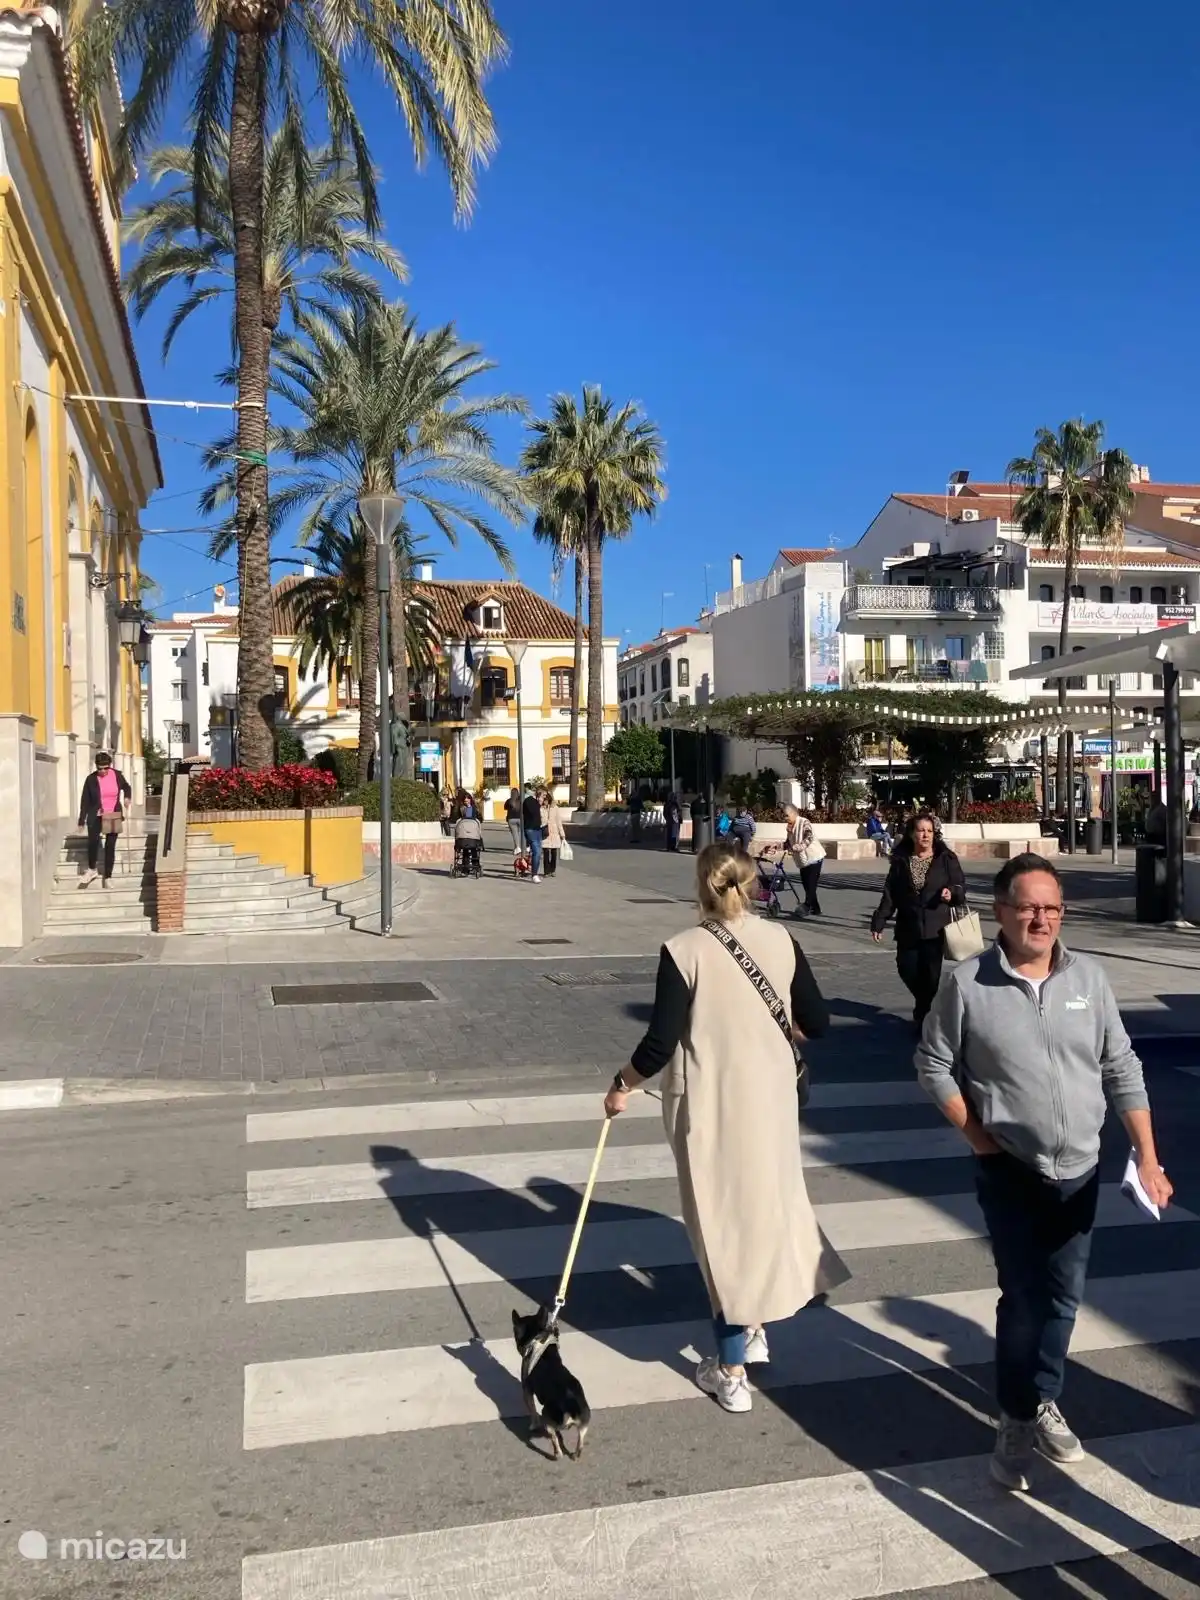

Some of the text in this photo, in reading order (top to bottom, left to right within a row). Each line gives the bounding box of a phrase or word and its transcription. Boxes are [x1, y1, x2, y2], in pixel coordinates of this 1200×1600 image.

[1095, 605, 1108, 619] &
[1109, 604, 1154, 619] Asociados
[1085, 743, 1107, 752] Allianz
